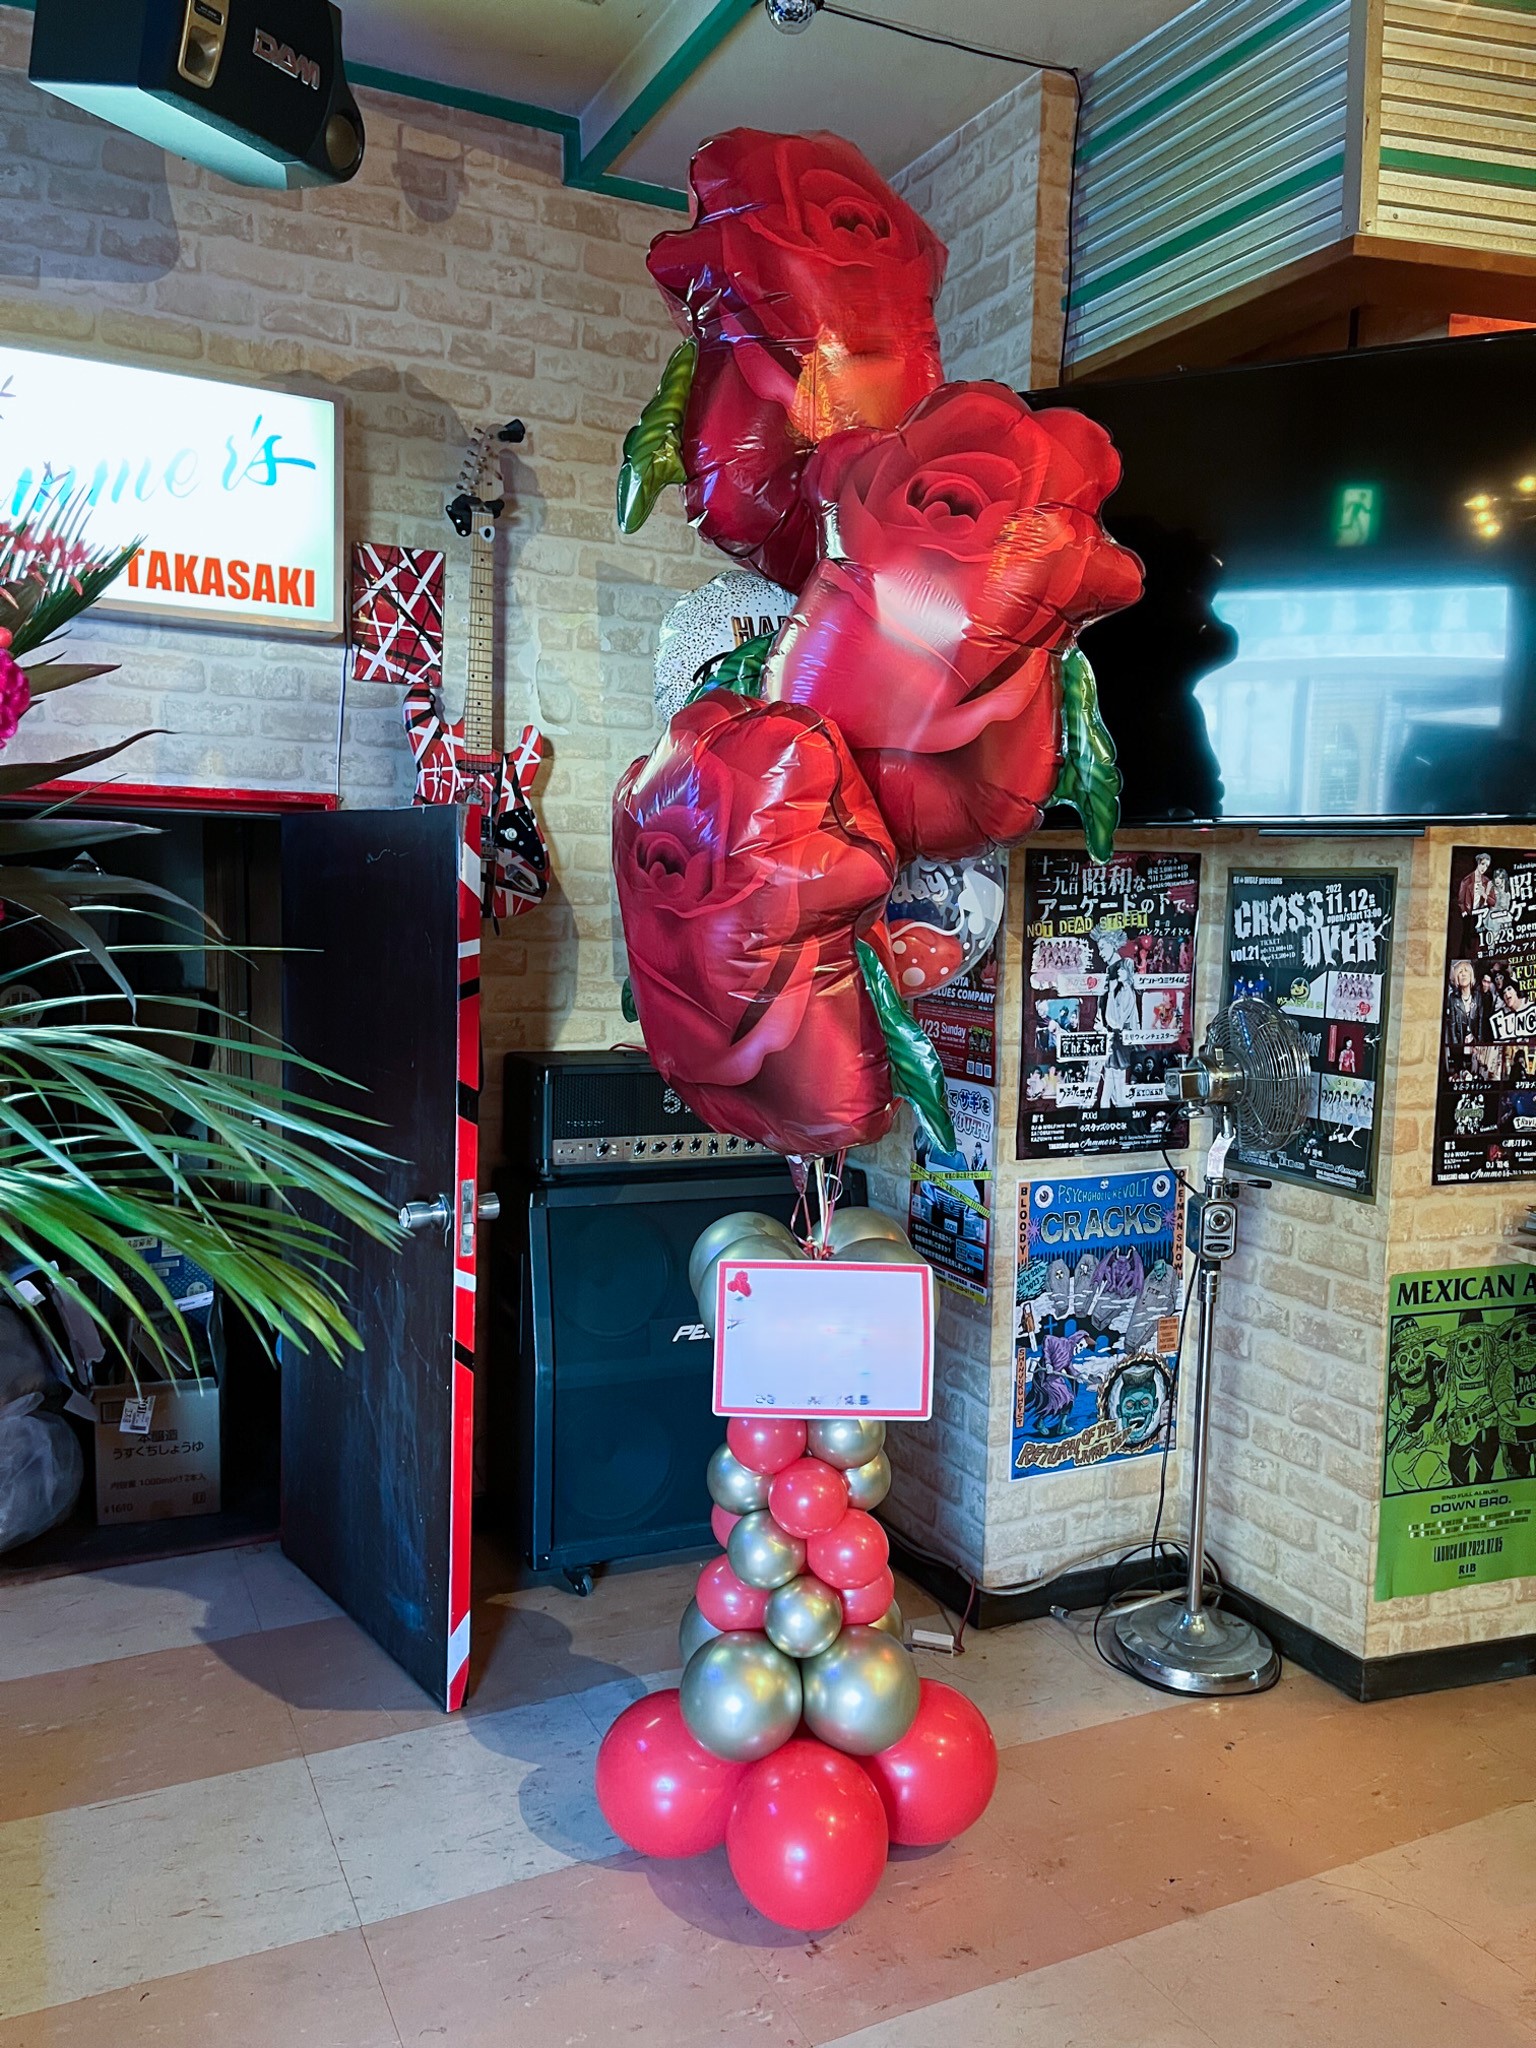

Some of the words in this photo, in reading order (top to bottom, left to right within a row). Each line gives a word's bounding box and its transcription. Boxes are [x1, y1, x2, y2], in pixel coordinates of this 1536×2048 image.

[253, 27, 321, 91] DAM
[121, 545, 315, 608] TAKASAKI
[1259, 876, 1283, 885] presents
[1325, 884, 1342, 894] 2022
[1325, 888, 1369, 914] 11.12
[1026, 920, 1053, 938] NOT
[1059, 915, 1094, 935] DEAD
[1099, 910, 1148, 932] STREET
[1234, 890, 1324, 940] CROSS
[1301, 920, 1377, 969] OVER
[1526, 954, 1536, 962] CO
[951, 976, 970, 988] OTA
[957, 990, 996, 1004] COMPANY
[941, 1021, 967, 1039] Sunday
[1019, 1186, 1028, 1256] BLOODY
[1040, 1203, 1163, 1244] CRACKS
[1174, 1233, 1184, 1271] SHOW
[1026, 1278, 1040, 1292] 2023
[1396, 1273, 1516, 1306] MEXICAN
[113, 1441, 204, 1460] うすくちしょうゆ
[1017, 1438, 1081, 1467] RETURN
[1081, 1428, 1097, 1445] OF
[1097, 1420, 1117, 1438] THE
[1074, 1441, 1109, 1465] LIVING
[1430, 1501, 1475, 1514] DOWN
[1478, 1495, 1511, 1509] BRO.
[1474, 1489, 1498, 1497] ALBUM
[1458, 1563, 1477, 1575] RIB
